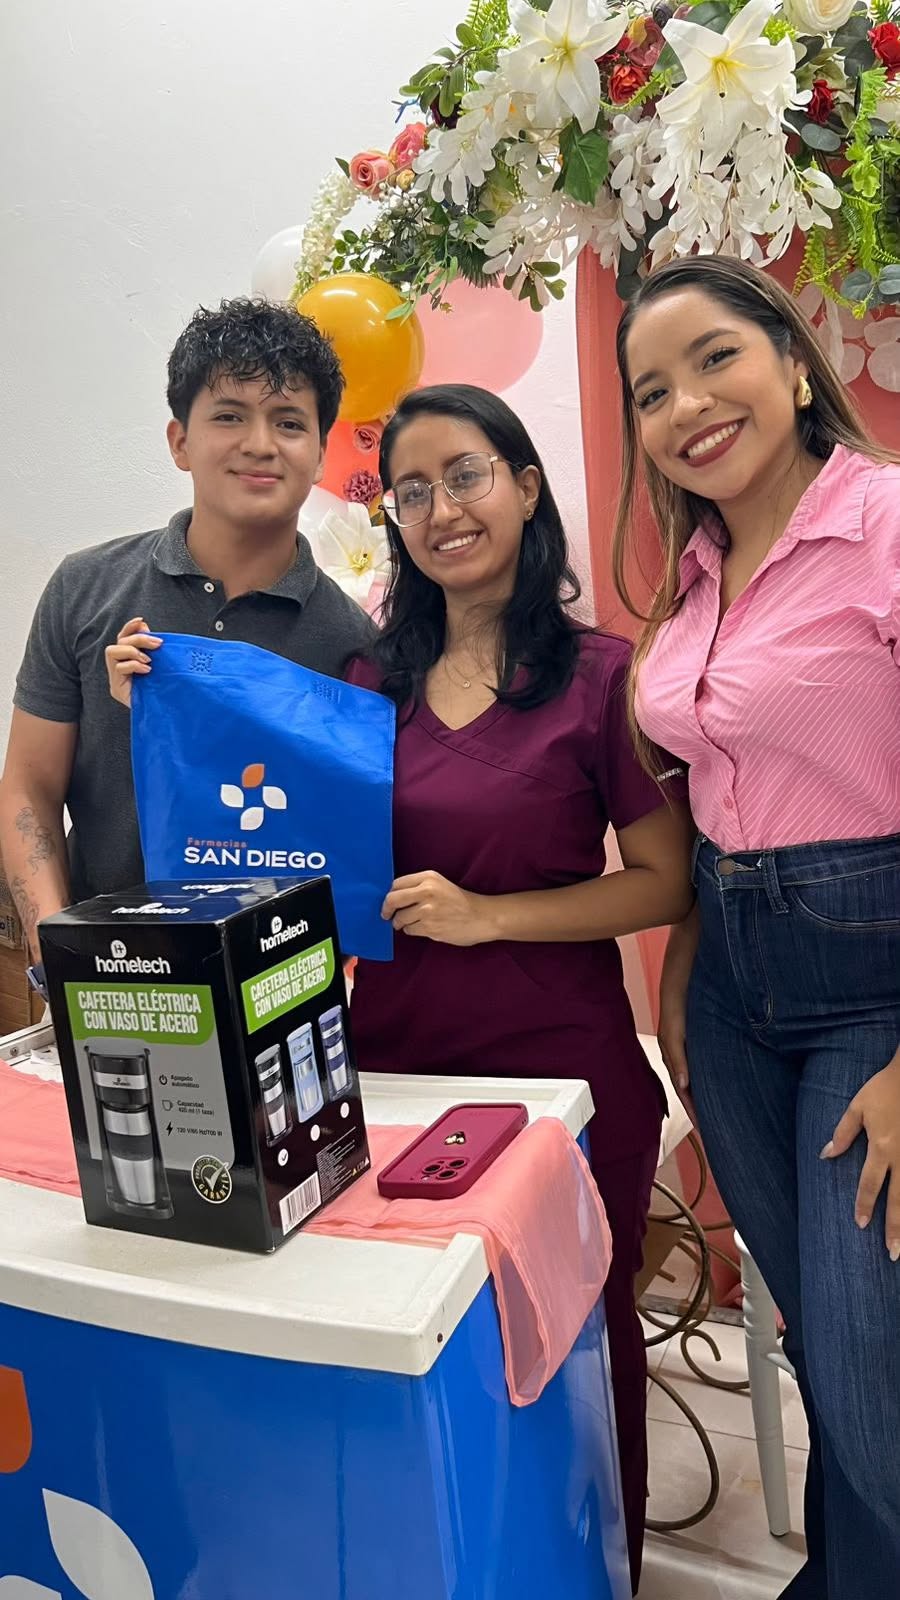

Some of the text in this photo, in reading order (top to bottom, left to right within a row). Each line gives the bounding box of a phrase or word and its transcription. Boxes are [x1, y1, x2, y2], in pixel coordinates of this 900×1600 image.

[187, 837, 248, 848] Farmacias
[184, 847, 326, 869] SAN DIEGO
[260, 919, 309, 953] hometech
[95, 955, 171, 974] hometech
[250, 968, 290, 1002] CAFETERA
[255, 966, 326, 1018] CON VASO DE ACERO
[77, 989, 202, 1014] CAFETERA ELÉCTRICA
[84, 1011, 199, 1034] CON VASO DE ACERO
